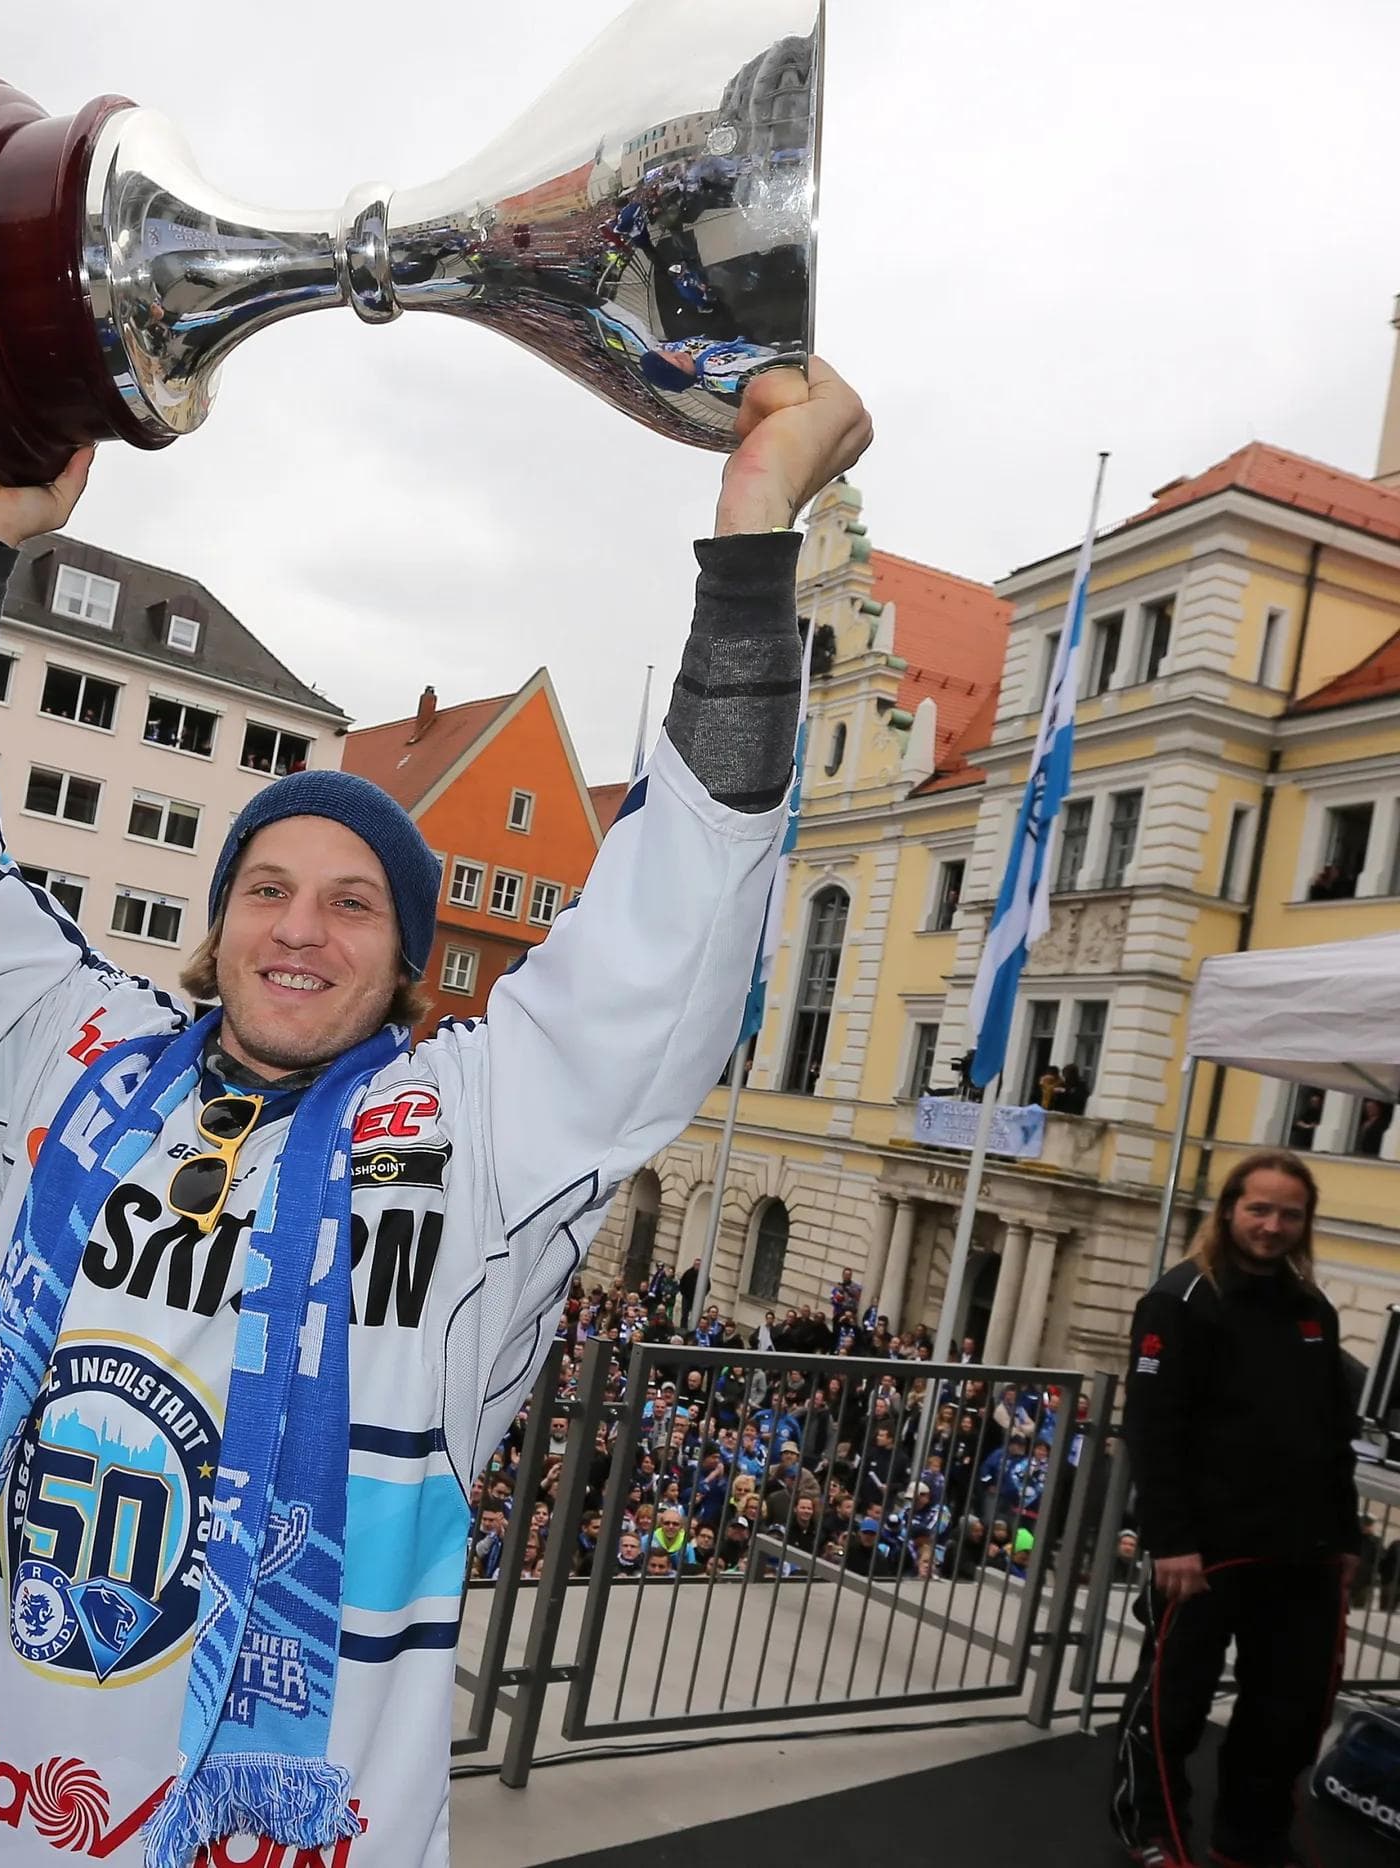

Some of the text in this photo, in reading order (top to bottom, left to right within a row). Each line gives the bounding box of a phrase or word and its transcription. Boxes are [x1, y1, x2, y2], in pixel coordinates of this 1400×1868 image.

[70, 1356, 209, 1451] INGOLSTADT
[21, 1439, 176, 1602] 50
[19, 1566, 63, 1588] ERC
